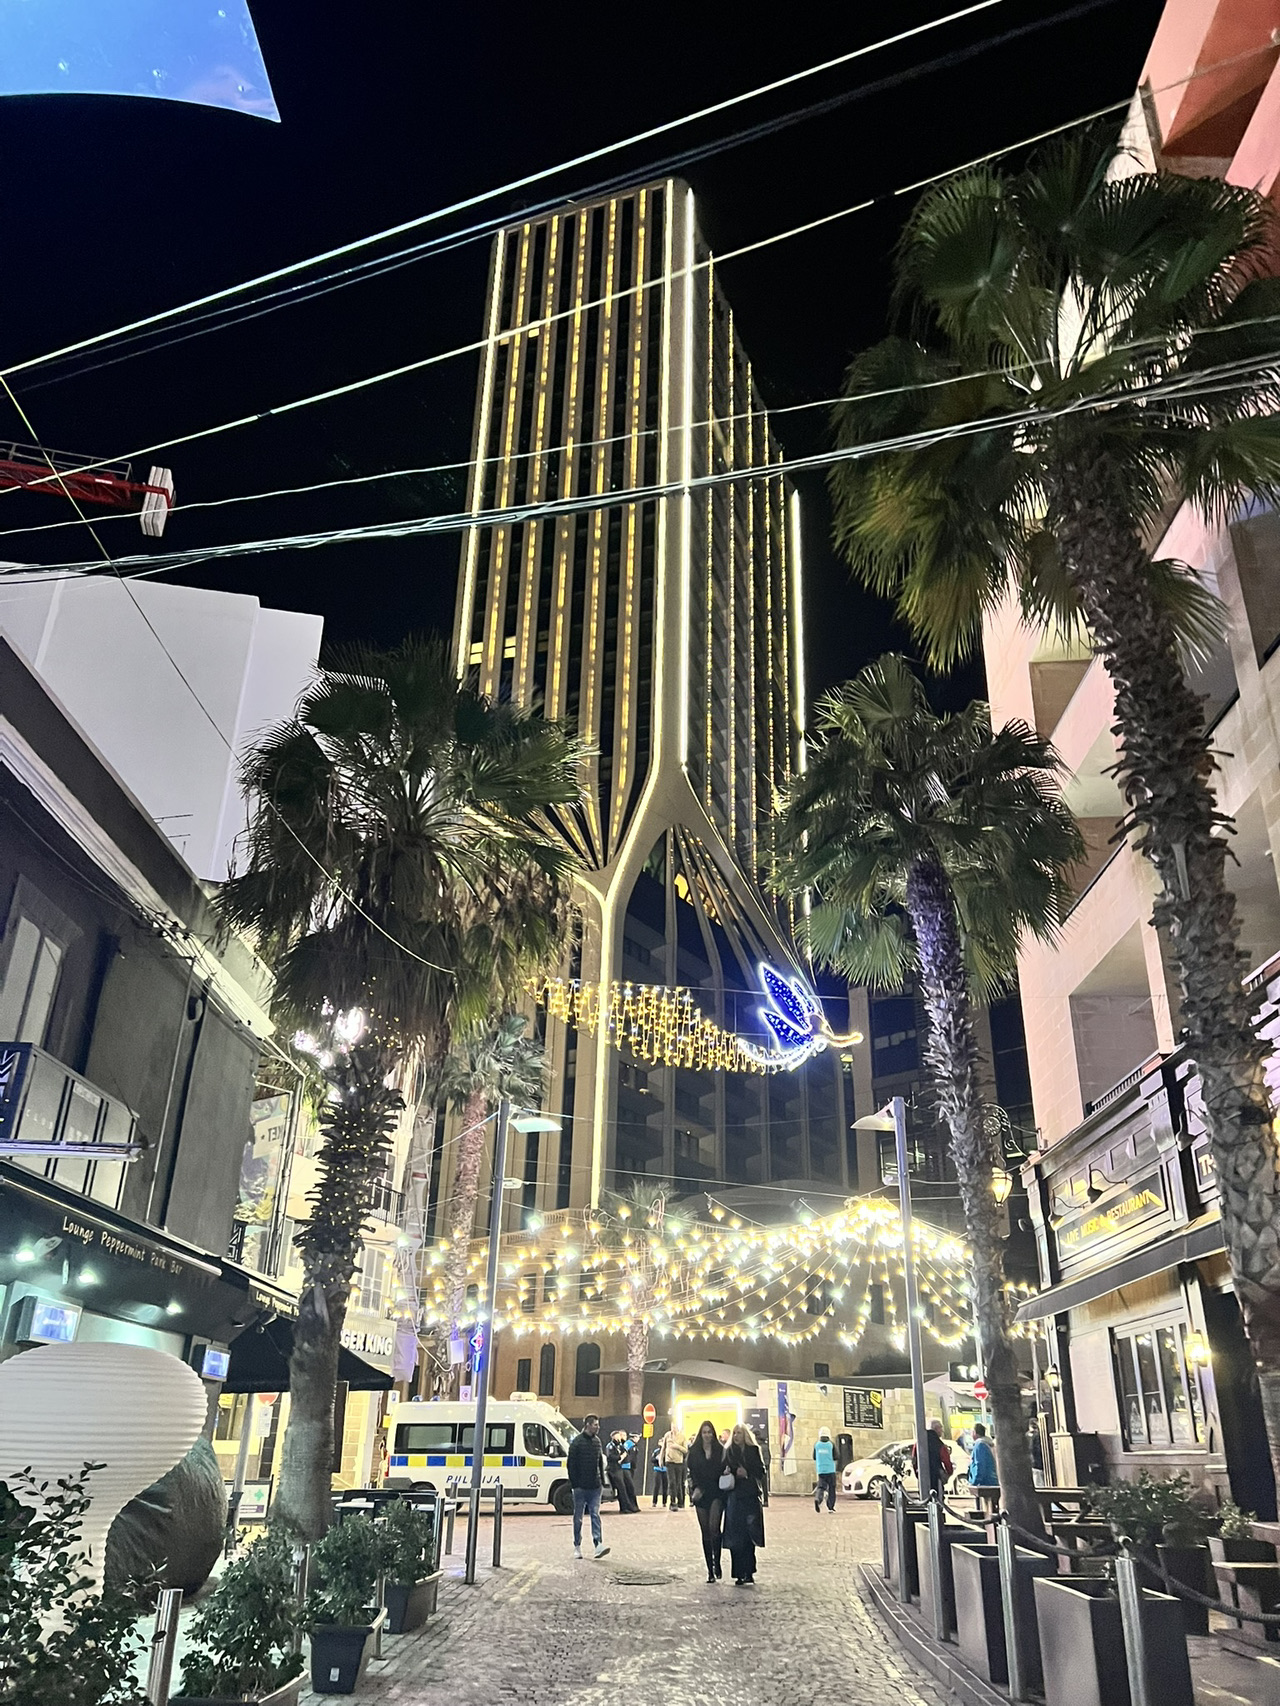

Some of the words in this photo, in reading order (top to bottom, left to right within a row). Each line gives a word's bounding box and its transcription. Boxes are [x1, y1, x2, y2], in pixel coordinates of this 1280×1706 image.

[1107, 1189, 1150, 1220] RESTAURANT
[63, 1216, 94, 1245] Lounge
[101, 1231, 146, 1262] Peppermint
[150, 1252, 166, 1270] Park
[170, 1260, 183, 1275] Bar
[365, 1333, 393, 1356] KING
